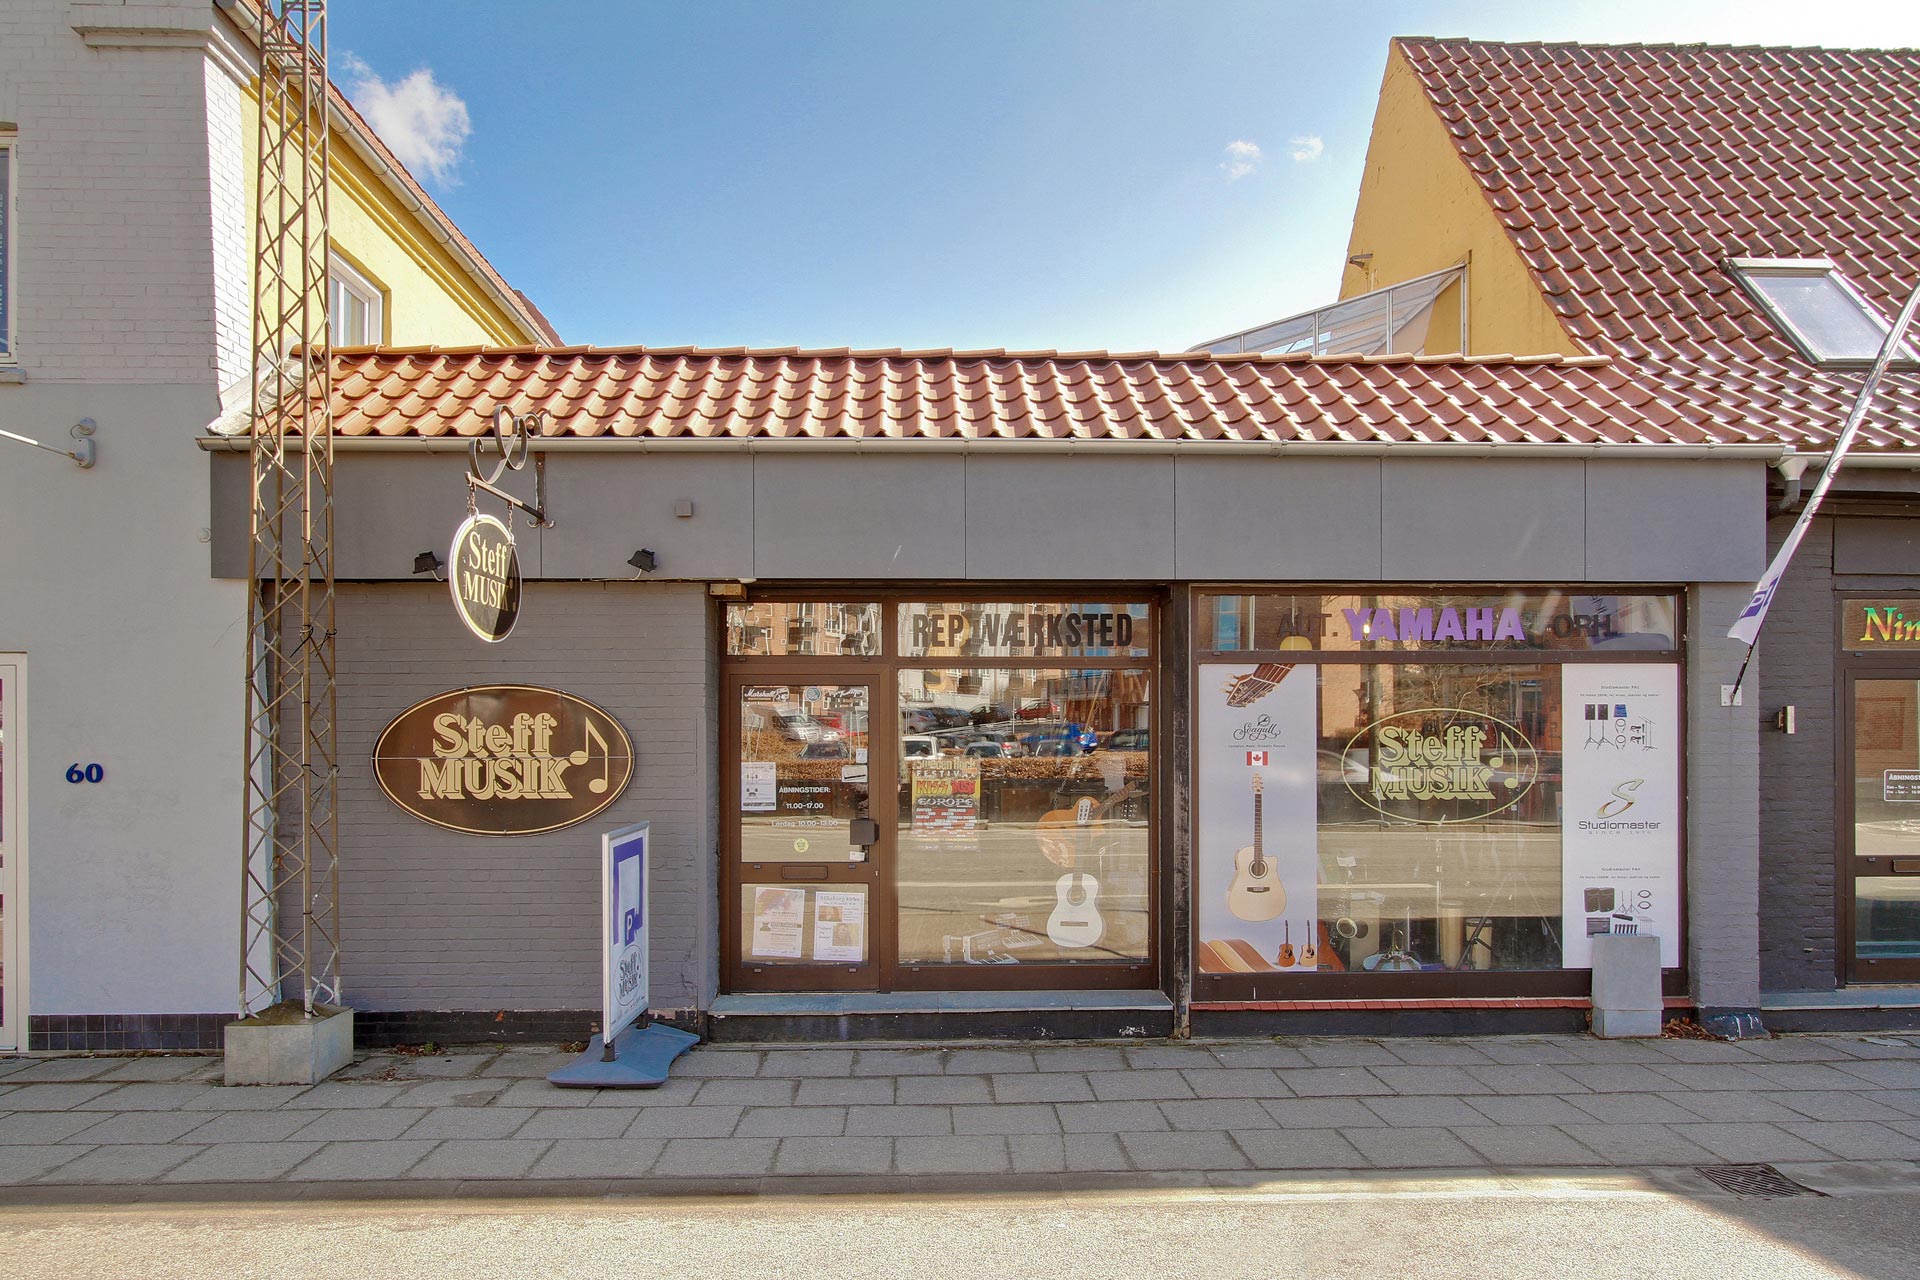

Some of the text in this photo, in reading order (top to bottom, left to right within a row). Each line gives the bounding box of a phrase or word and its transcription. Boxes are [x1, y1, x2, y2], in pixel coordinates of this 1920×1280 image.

[469, 531, 507, 580] Steff
[463, 571, 509, 611] MUSIK
[912, 613, 1133, 648] REP VÆRKSTED
[1277, 613, 1339, 638] AUT.
[1343, 607, 1526, 641] YAMAHA
[744, 688, 777, 698] Marshall
[433, 712, 558, 759] Steff
[1233, 722, 1282, 742] Seagull
[1378, 725, 1488, 767] Steff
[65, 762, 104, 784] 60
[416, 757, 573, 800] MUSIK
[778, 786, 831, 794] ÅBNINGSTIDER:
[916, 780, 976, 796] KISS RUSH
[1369, 765, 1497, 801] MUSIK
[1578, 820, 1661, 830] Studiomaster
[626, 914, 633, 941] P
